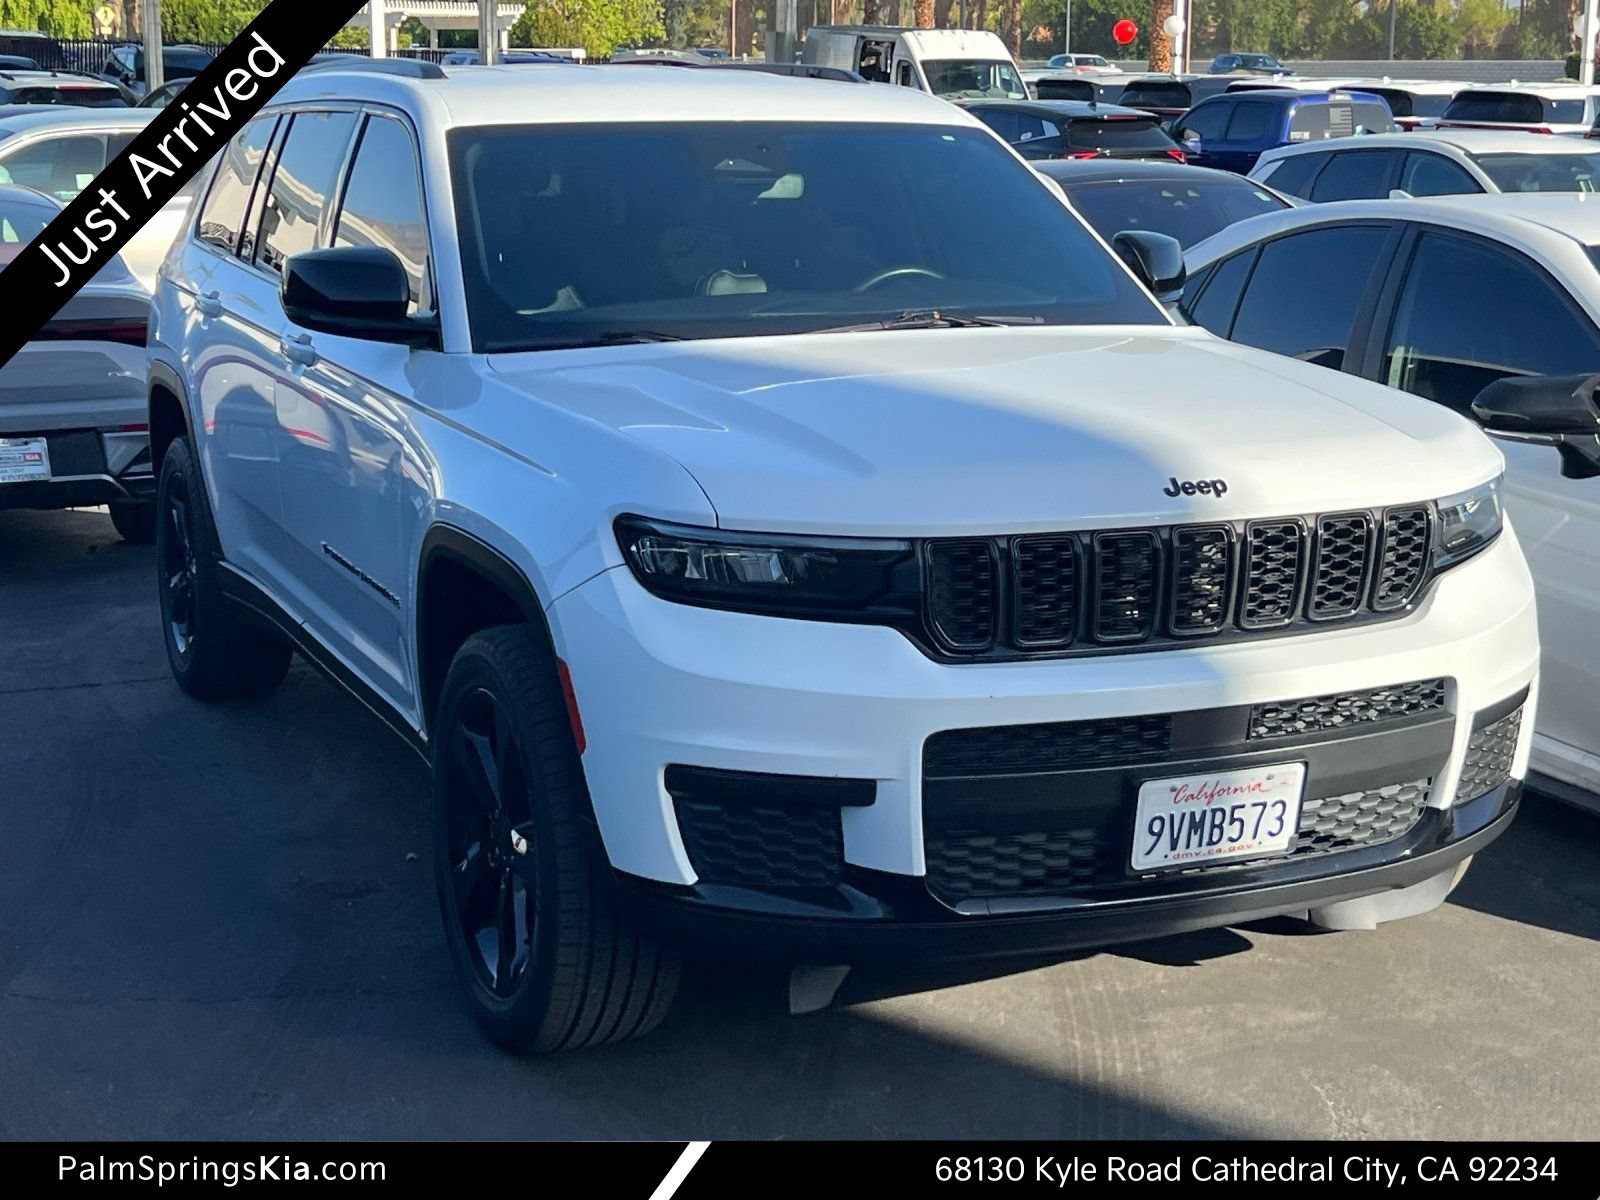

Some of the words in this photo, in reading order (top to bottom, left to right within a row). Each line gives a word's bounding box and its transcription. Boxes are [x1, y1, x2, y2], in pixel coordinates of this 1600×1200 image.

[1163, 477, 1228, 498] Jeep
[1173, 780, 1271, 806] California
[1144, 799, 1287, 856] 9VMB573
[1171, 843, 1254, 861] dmv.ca.gov
